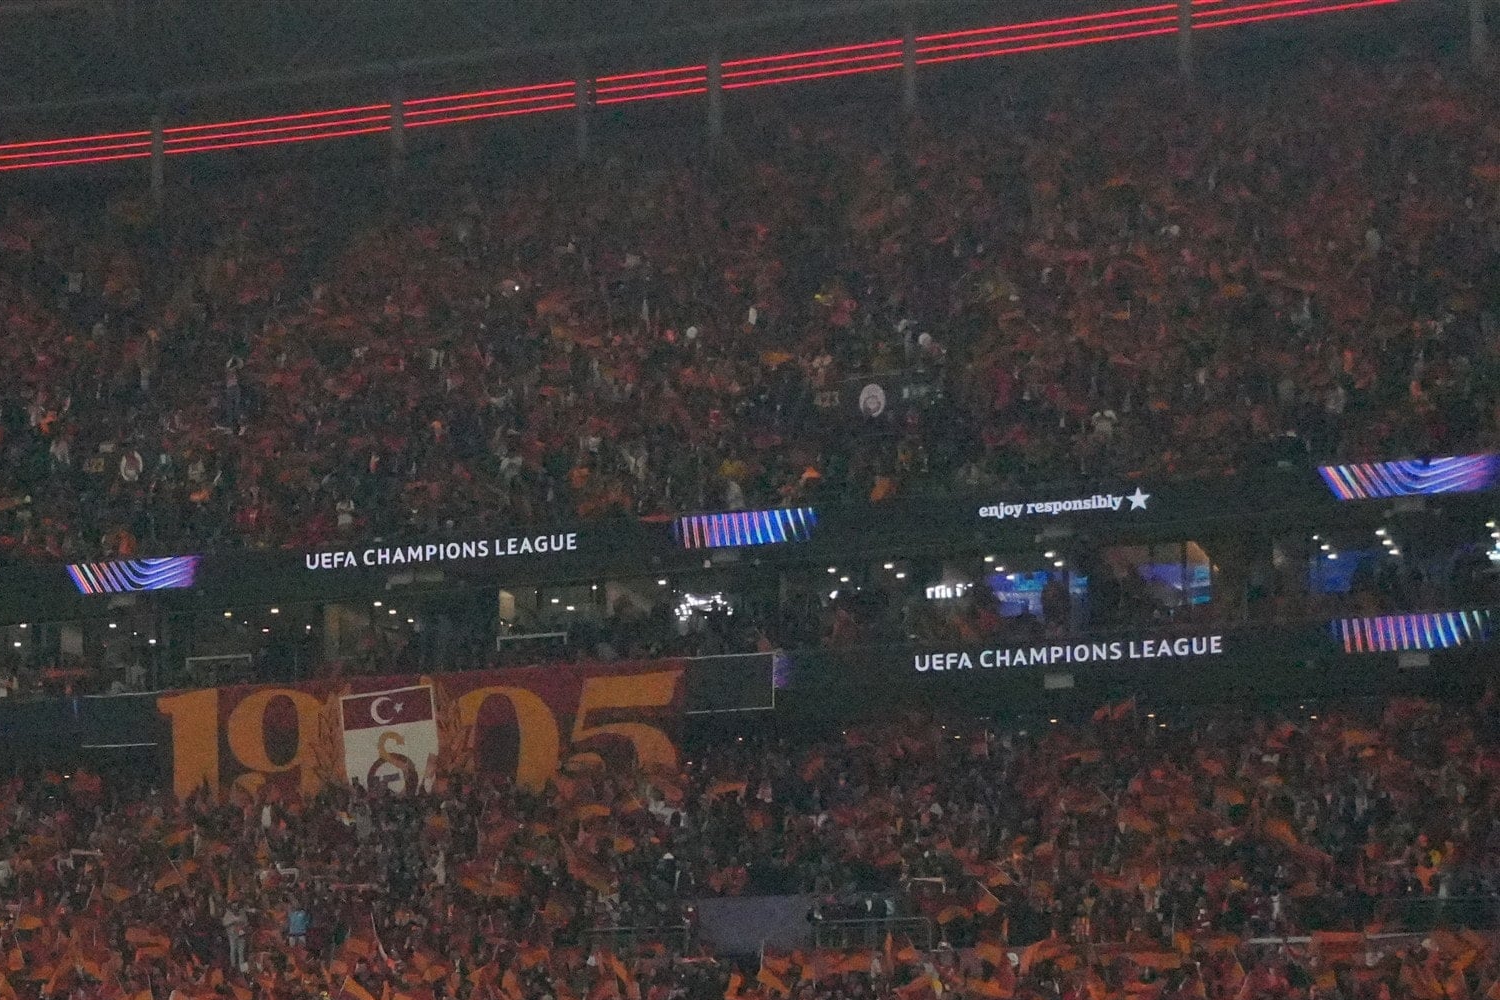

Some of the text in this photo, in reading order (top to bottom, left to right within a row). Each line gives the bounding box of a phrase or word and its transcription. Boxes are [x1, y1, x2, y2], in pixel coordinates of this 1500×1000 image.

[978, 494, 1124, 519] enjoy responsibly
[305, 533, 577, 570] UEFA CHAMPIONS LEAGUE
[914, 635, 1222, 672] UEFA CHAMPIONS LEAGUE
